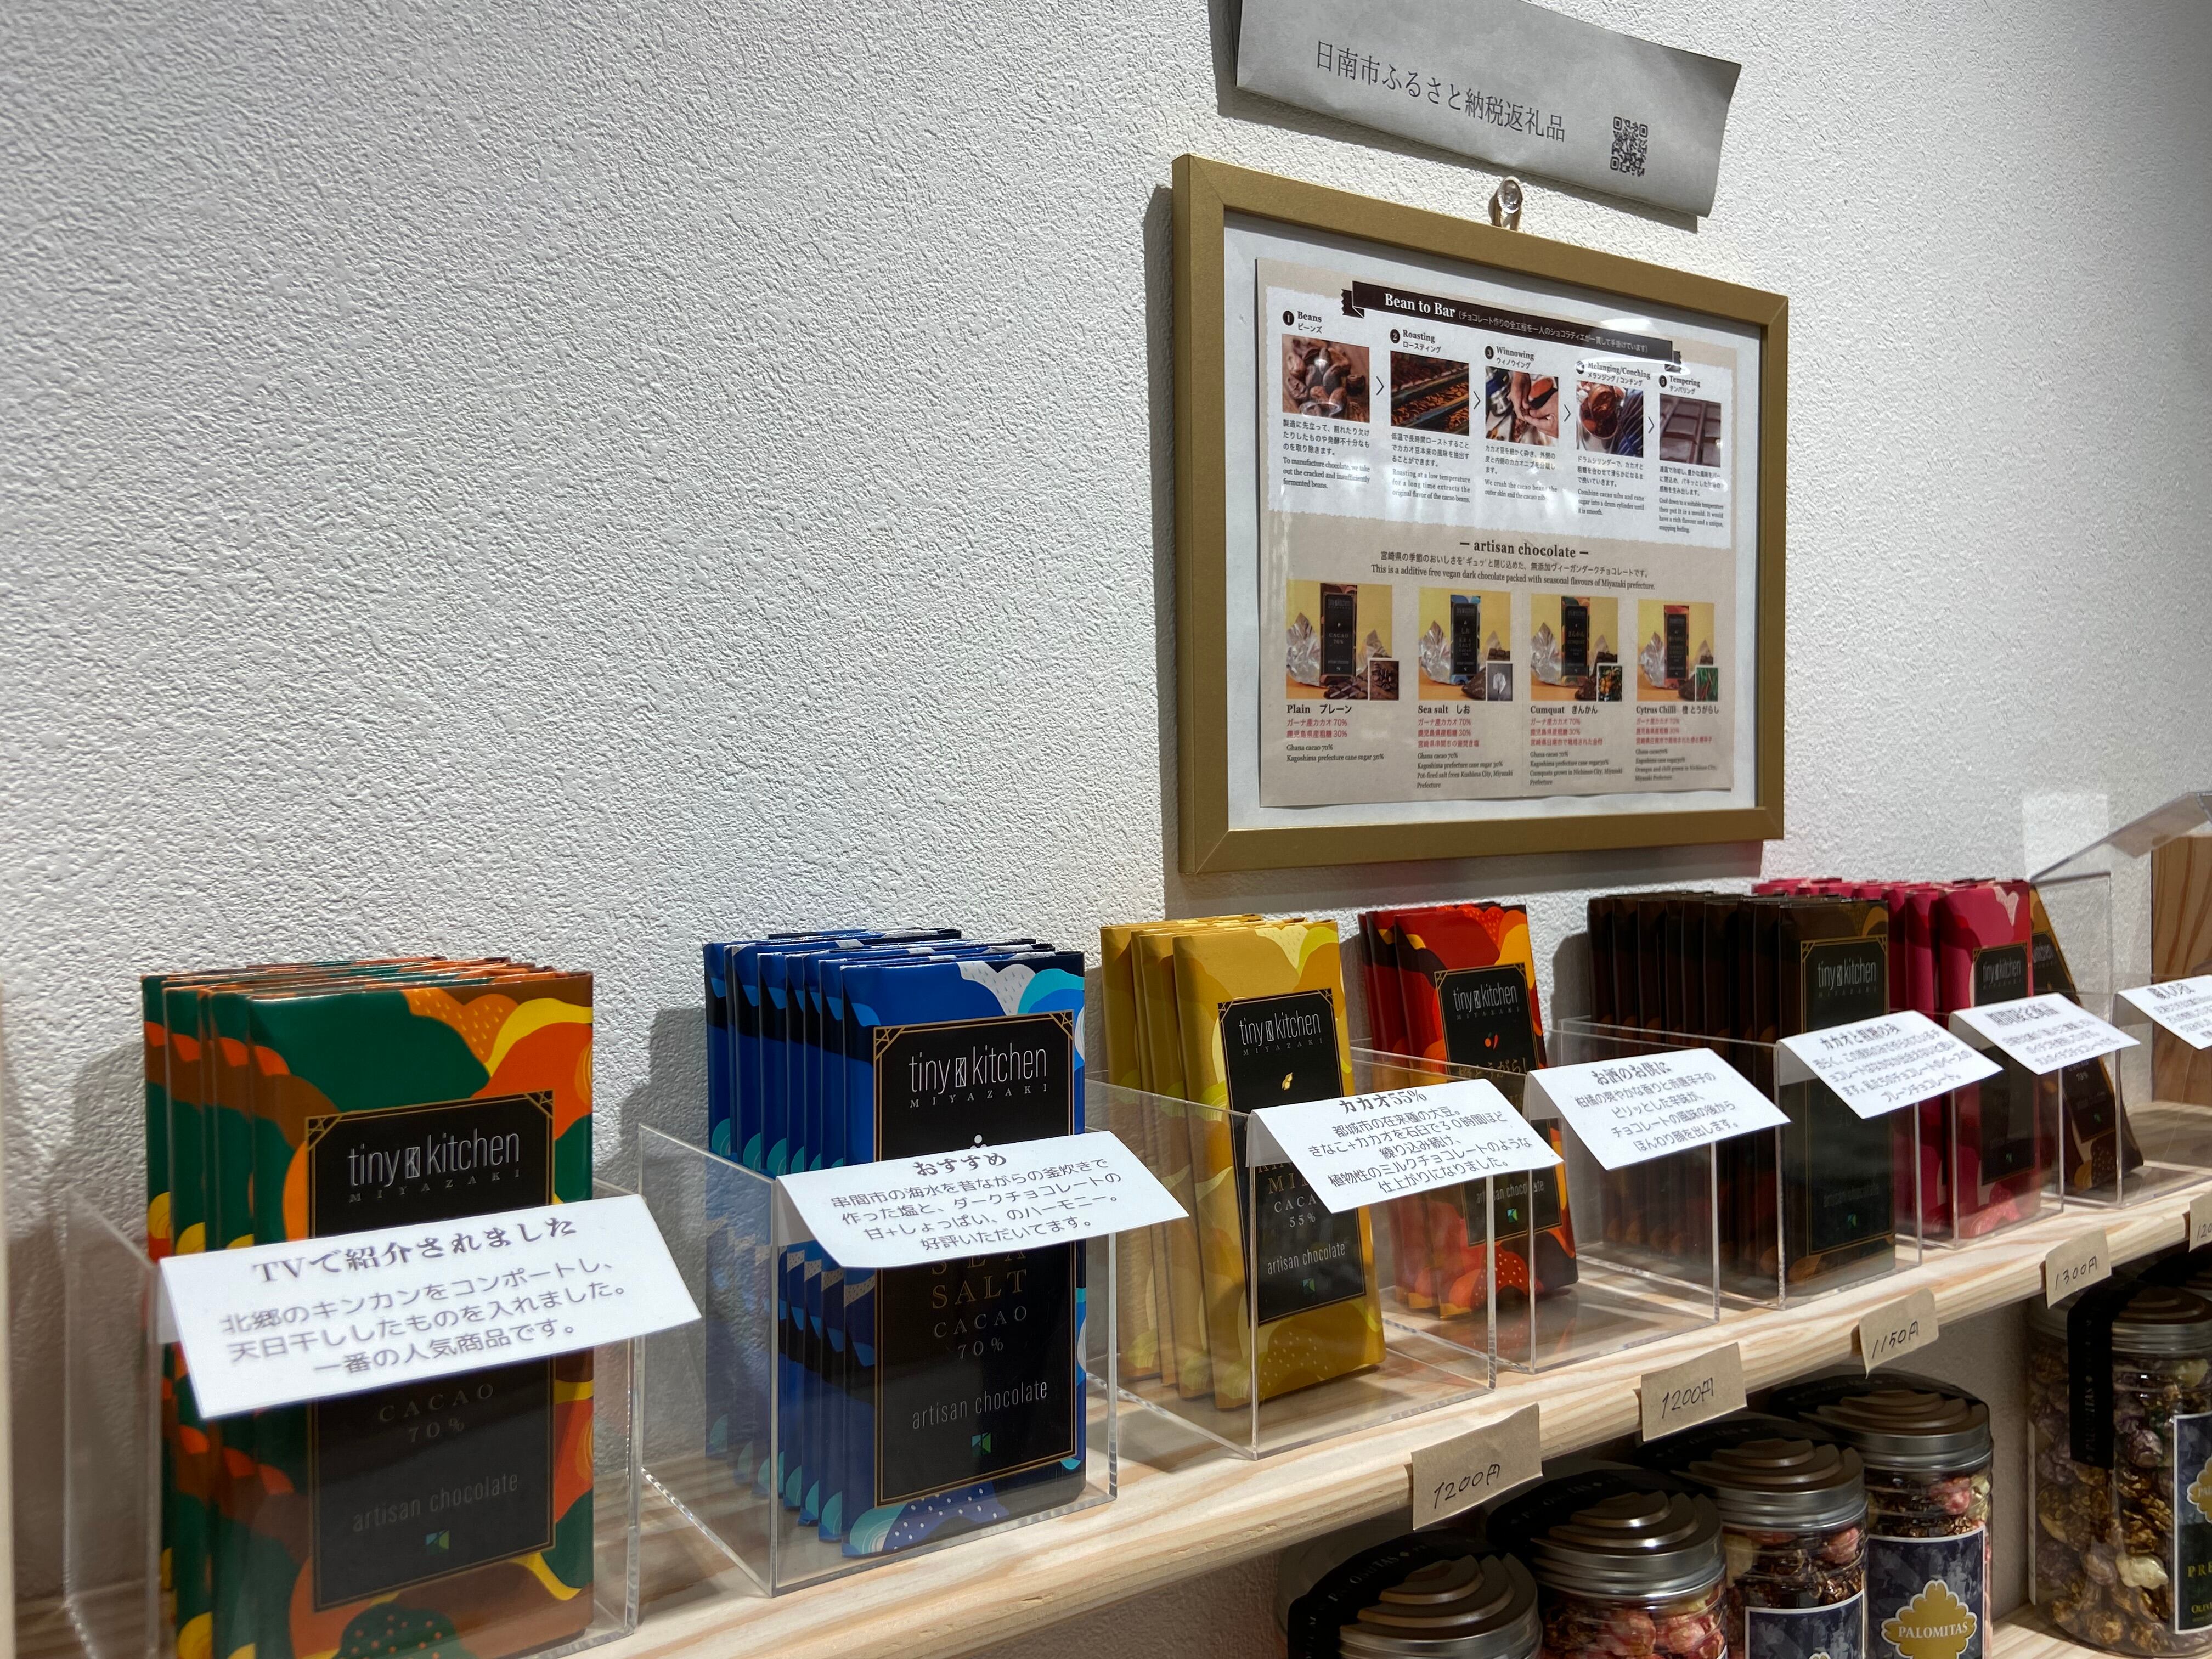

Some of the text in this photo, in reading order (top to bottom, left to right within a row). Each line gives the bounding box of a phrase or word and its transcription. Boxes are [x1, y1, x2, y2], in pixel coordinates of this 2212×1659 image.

[1316, 40, 1566, 143] 日南市ふるさと納税返礼品
[1297, 312, 1322, 323] Beans
[1385, 293, 1455, 318] Bean to Bar
[1298, 323, 1322, 334] ビーンズ
[1403, 330, 1435, 343] Roasting
[1496, 346, 1534, 360] Winnowing
[1587, 362, 1650, 380] Melanging/Conching
[1669, 375, 1700, 387] Tempering
[1283, 443, 1335, 455] のを取り除きます。
[1291, 459, 1324, 467] manufacture
[1304, 470, 1324, 478] cracked
[1283, 478, 1311, 487] fermented
[1392, 469, 1416, 478] Roasting
[1440, 474, 1470, 483] temperature
[1474, 540, 1576, 558] artisan chocolate
[1372, 564, 1386, 574] This
[1388, 565, 1393, 574] is
[1401, 566, 1426, 576] additive
[1429, 568, 1441, 577] free
[1442, 570, 1460, 579] vegan
[1462, 569, 1476, 579] dark
[1477, 571, 1505, 581] chocolate
[1506, 573, 1526, 583] packed
[1528, 575, 1542, 583] with
[1544, 576, 1569, 585] seasonal
[1571, 577, 1593, 586] flavours
[1594, 578, 1601, 586] of
[1602, 579, 1626, 589] Miyazaki
[1287, 704, 1352, 714] Plain プレーン
[1418, 705, 1470, 714] Sea salt しお
[1531, 706, 1598, 715] Cumquat きんかん
[1636, 706, 1657, 715] Cytrus
[1286, 754, 1316, 763] Kagoshima
[1818, 957, 1876, 991] tiny kitchen
[1453, 982, 1517, 1013] tiny kitchen
[1239, 1010, 1321, 1046] tiny kitchen
[1243, 1038, 1322, 1056] MIYAZAKI
[909, 1042, 1047, 1094] tiny kitchen
[1592, 1061, 1672, 1086] お酒のお供に
[910, 1084, 1047, 1109] MIYAZAKI
[1339, 1088, 1427, 1114] カカオ55%
[1332, 1106, 1461, 1138] 都城市の在来種の大豆。
[1610, 1100, 1736, 1138] チョコレートの風味の後から
[347, 1128, 520, 1188] tiny kitchen
[1379, 1136, 1462, 1160] 練り込み続け、
[912, 1152, 1007, 1177] おすすめ
[1328, 1136, 1533, 1187] 植物性のミルクチョコレートのような
[348, 1169, 521, 1204] MIYAZAKI
[1379, 1158, 1509, 1194] 仕上がりになりました。
[842, 1171, 1121, 1226] 作った塩と、ダークチョコレートの
[1274, 1194, 1317, 1212] CACA
[1476, 1180, 1544, 1203] artsan chocoate
[1289, 1212, 1316, 1228] 55%
[920, 1216, 1092, 1251] 好評いただいてます。
[251, 1216, 578, 1284] TVで紹介されました
[1267, 1243, 1345, 1275] artisan chocolate
[2055, 1255, 2098, 1290] 1300円
[221, 1256, 614, 1338] 北郷のキンカンをコンポートし、
[932, 1269, 1026, 1308] SALT
[227, 1281, 627, 1364] 天日干ししたものを入れました。
[934, 1305, 1028, 1338] CACAO
[314, 1320, 577, 1376] 一番の人気商品です。
[957, 1336, 1005, 1359] 70%
[378, 1383, 494, 1422] CACAO
[912, 1380, 1048, 1429] artisan chocolate
[1662, 1377, 1714, 1419] 1200円
[408, 1416, 466, 1443] 70%
[1434, 1463, 1500, 1509] 1200円
[352, 1473, 518, 1533] artisan chocolate
[1898, 1621, 1968, 1639] PALOMITAS
